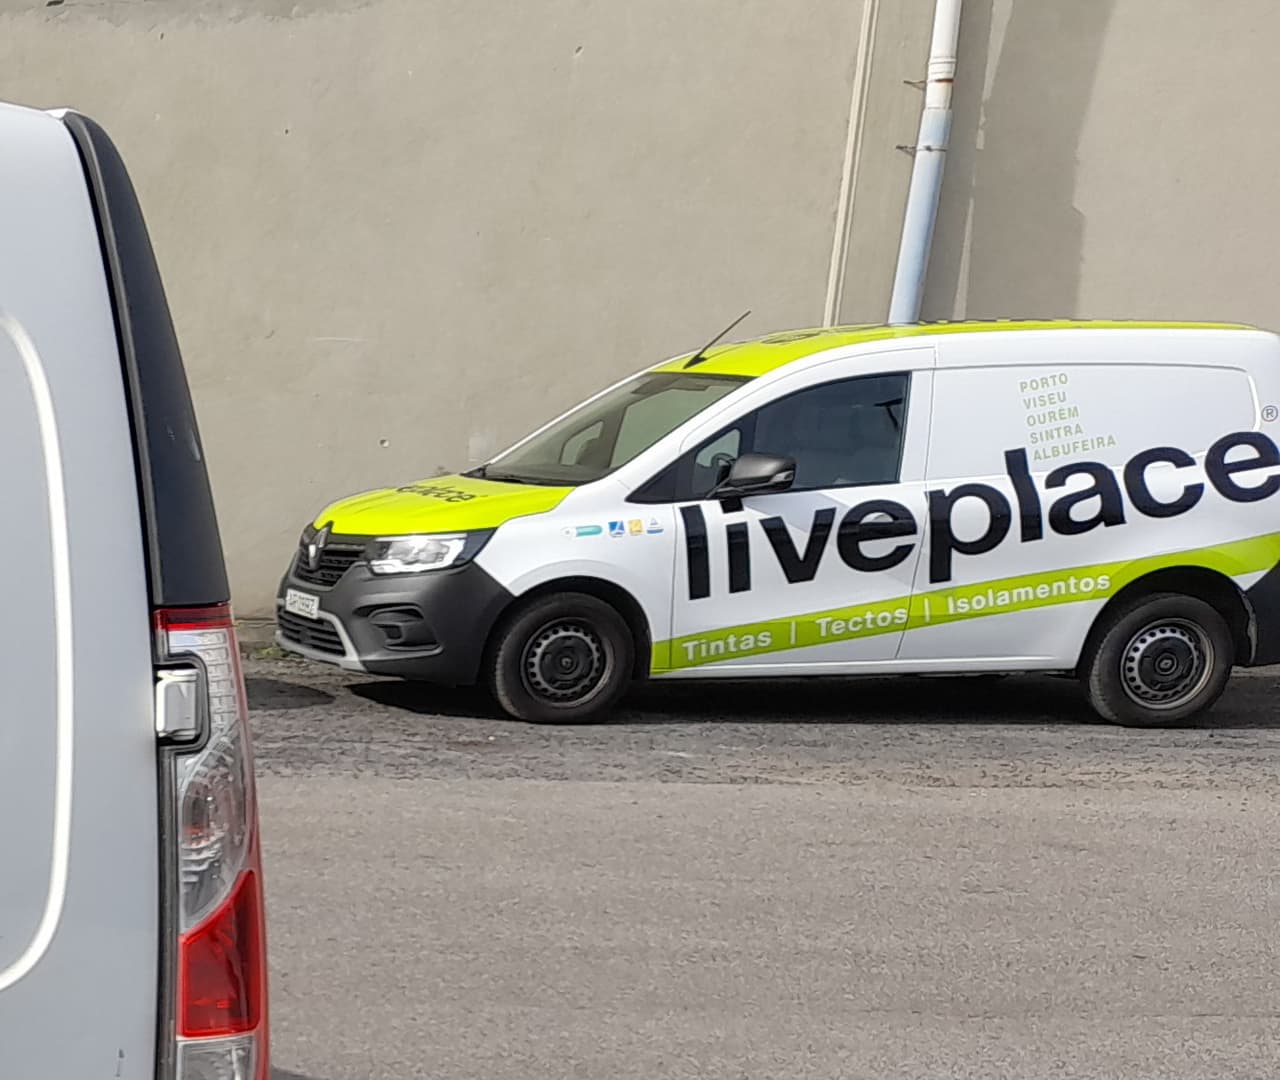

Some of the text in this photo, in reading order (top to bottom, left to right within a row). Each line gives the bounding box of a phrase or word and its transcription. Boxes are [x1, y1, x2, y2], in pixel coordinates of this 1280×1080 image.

[1019, 373, 1068, 392] PORTO
[1023, 391, 1067, 409] VISEU
[1030, 423, 1083, 444] SINTRA
[1033, 435, 1116, 461] ALBUFEIRA
[680, 431, 1280, 600] liveplace
[682, 572, 1111, 661] Tintas Tectos Isolamentos
